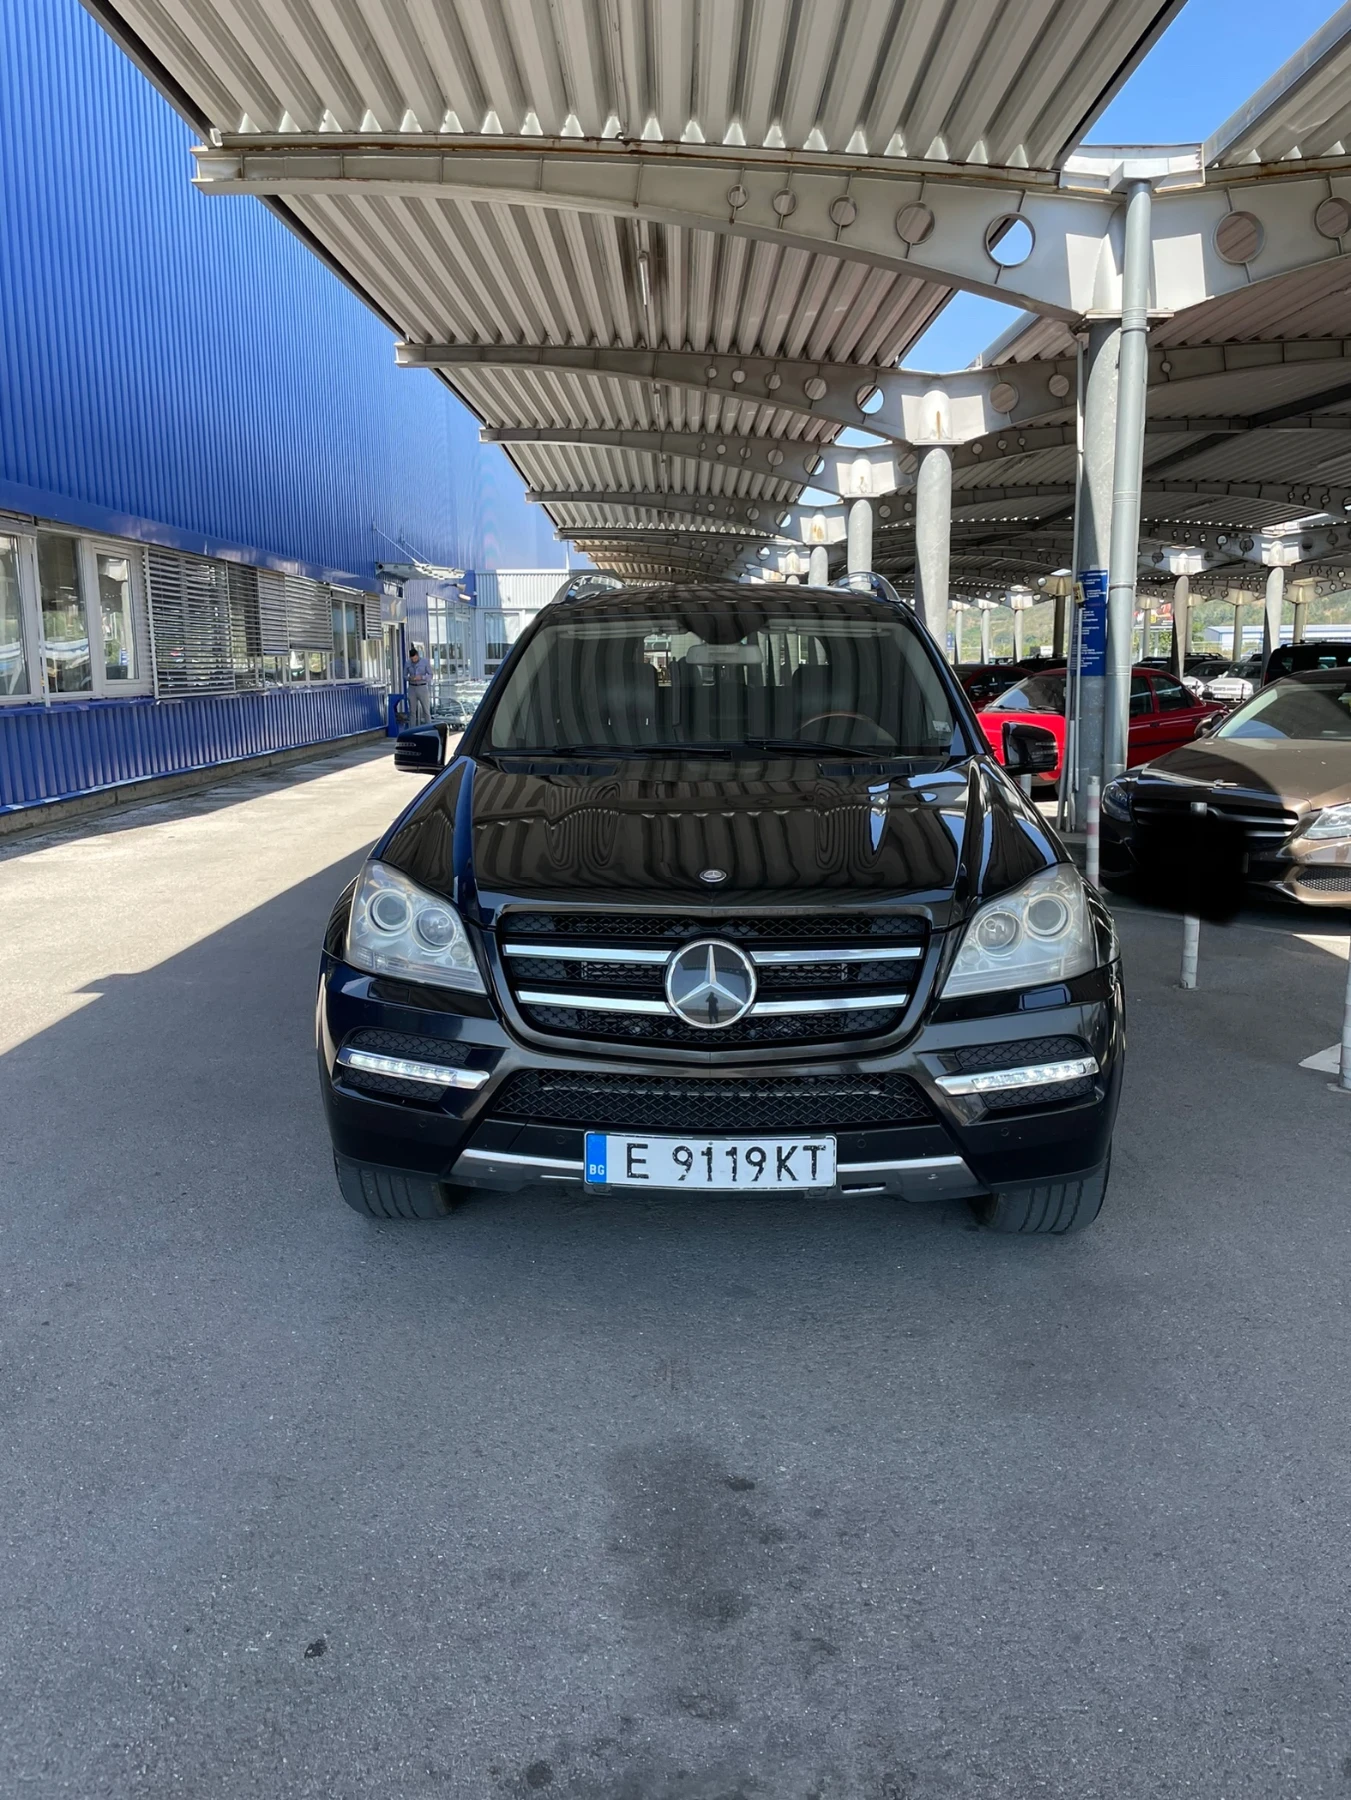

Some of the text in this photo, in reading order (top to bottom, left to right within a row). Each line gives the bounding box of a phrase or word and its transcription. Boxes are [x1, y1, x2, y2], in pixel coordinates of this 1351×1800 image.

[589, 1164, 605, 1176] BG
[626, 1142, 827, 1182] E 9119KT
